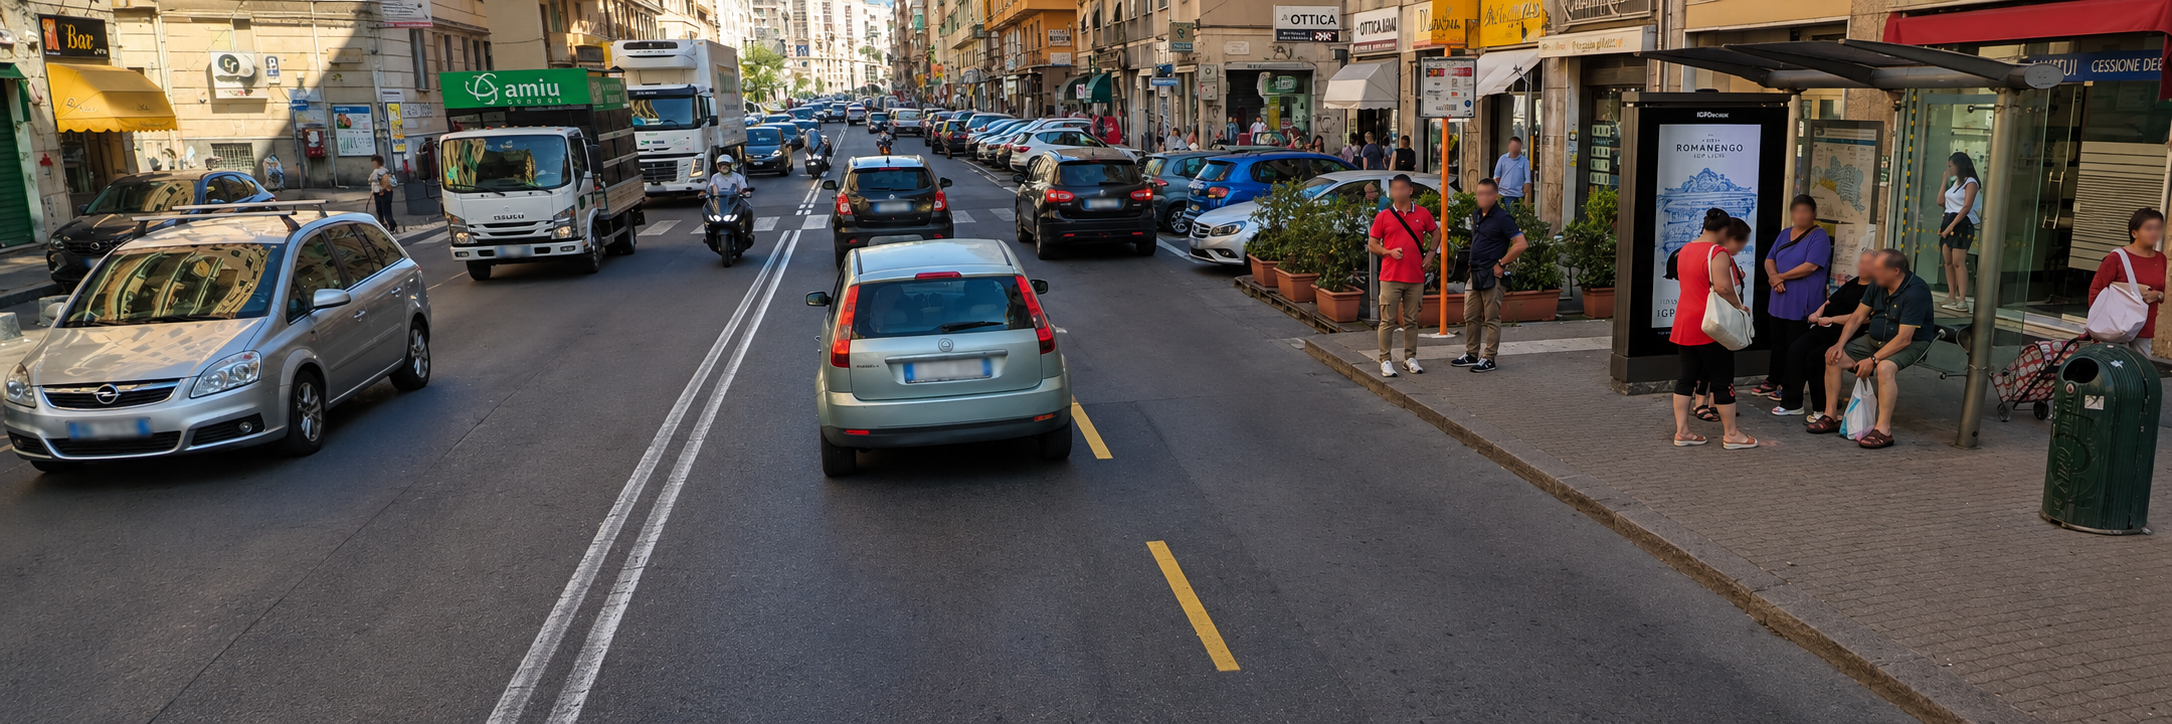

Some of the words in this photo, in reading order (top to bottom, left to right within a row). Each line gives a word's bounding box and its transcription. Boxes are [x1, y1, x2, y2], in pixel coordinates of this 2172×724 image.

[1290, 14, 1337, 25] OTTICA
[67, 23, 94, 50] Bar
[2091, 58, 2141, 73] CESSIONE
[505, 78, 560, 98] amiu
[1676, 144, 1744, 152] ROMANENGO
[1657, 308, 1676, 318] IGP
